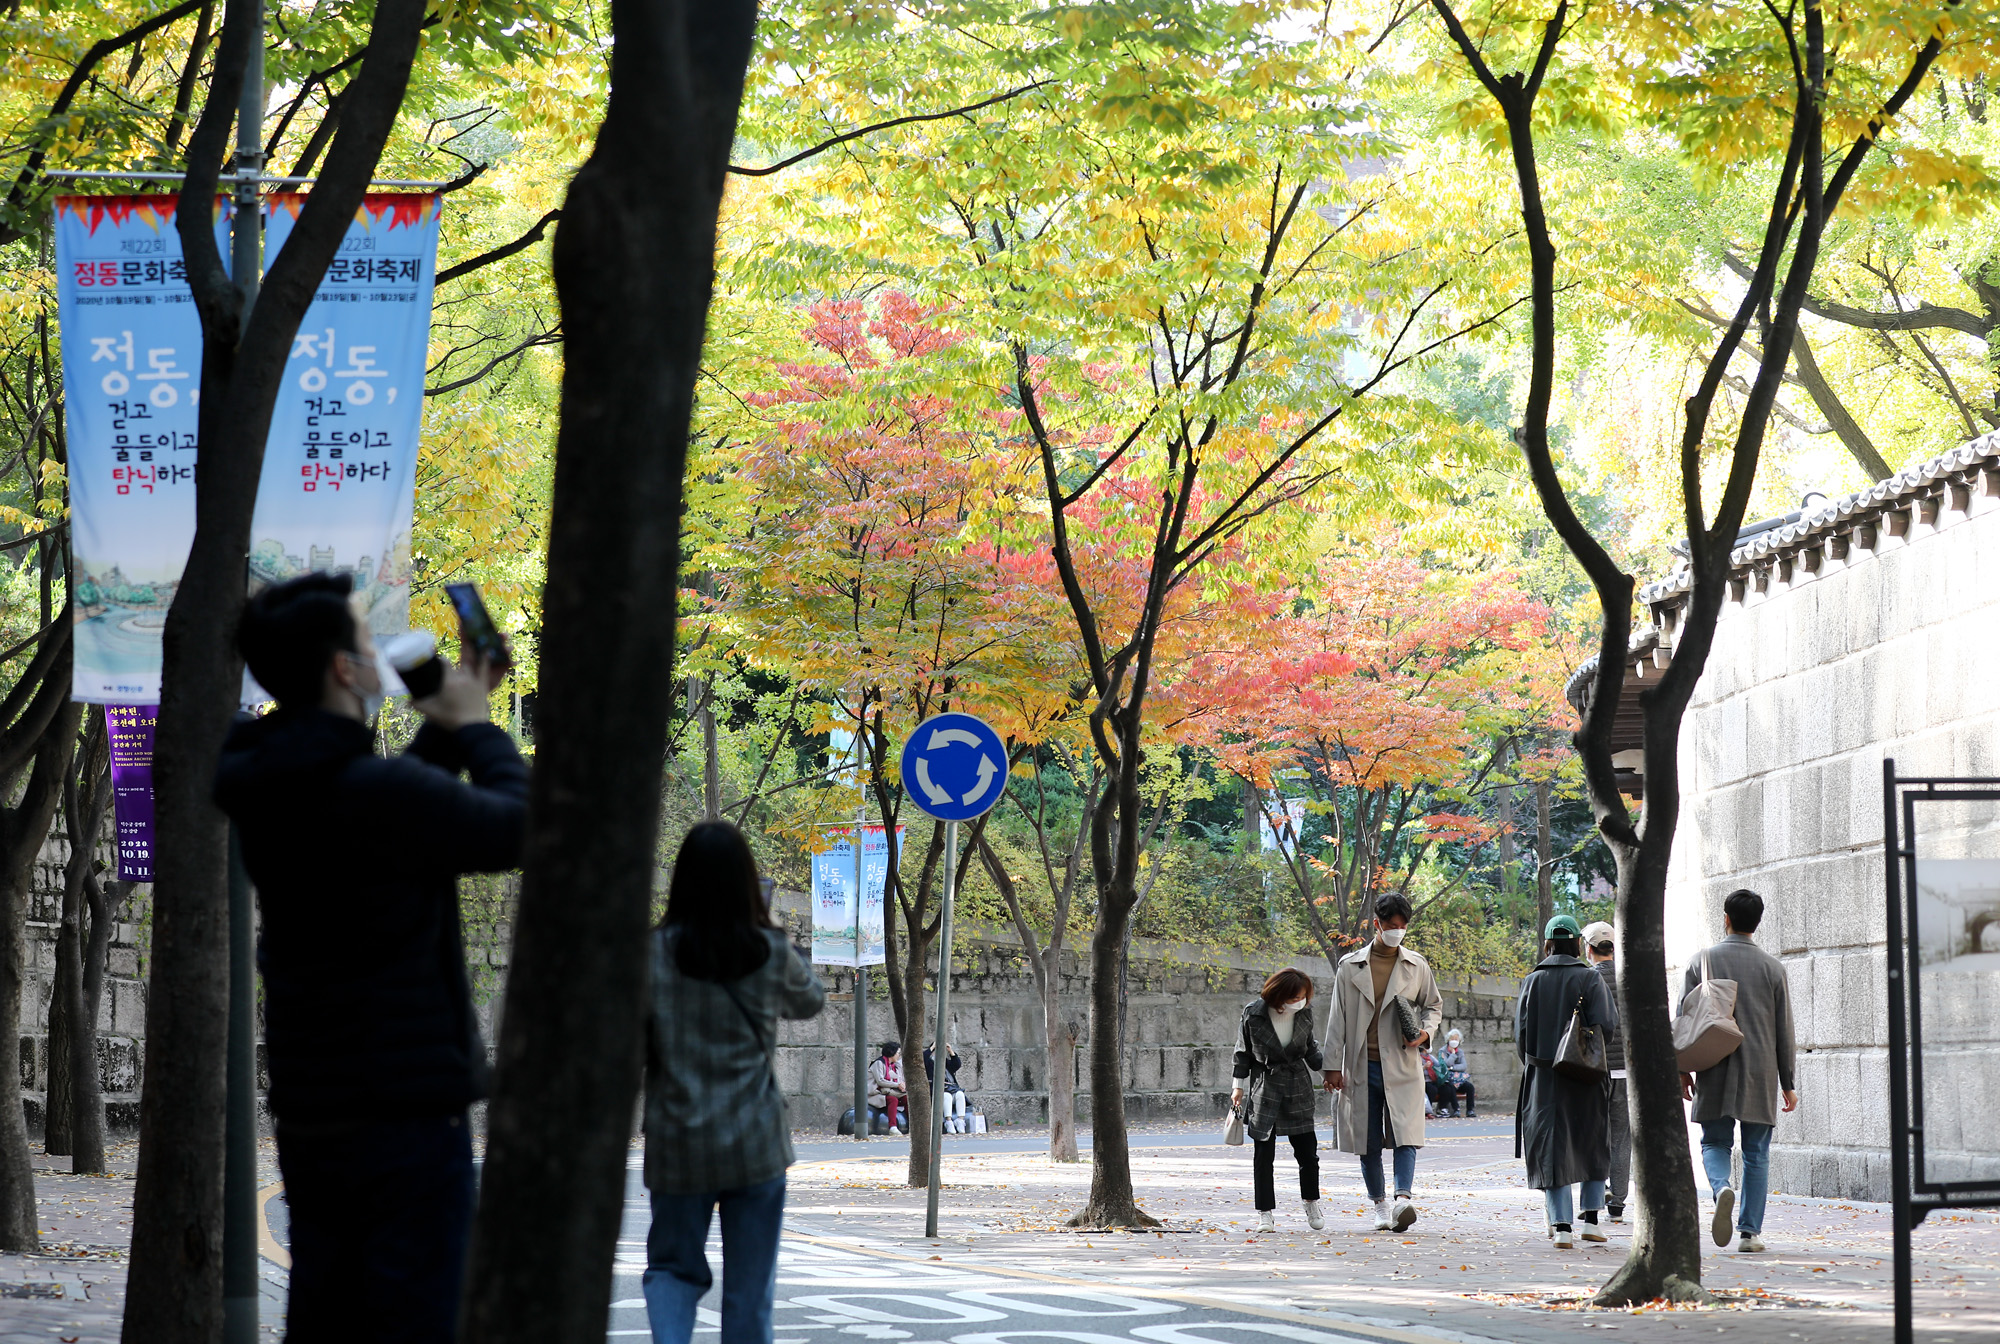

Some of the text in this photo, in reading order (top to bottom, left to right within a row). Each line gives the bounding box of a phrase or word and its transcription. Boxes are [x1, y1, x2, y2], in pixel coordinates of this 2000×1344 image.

[120, 238, 167, 254] 제22회
[341, 236, 376, 252] 22회
[74, 260, 189, 287] 정동문화축
[327, 258, 421, 283] 문화축제
[90, 330, 200, 408] 정동,
[291, 327, 398, 406] 정동,
[108, 400, 152, 429] 걷고
[304, 396, 347, 427] 걷고
[111, 431, 199, 462] 물들이고
[302, 428, 392, 460] 물들이고
[300, 461, 391, 492] 탐닉하다
[140, 717, 158, 727] 오다
[819, 863, 846, 885] 정동,
